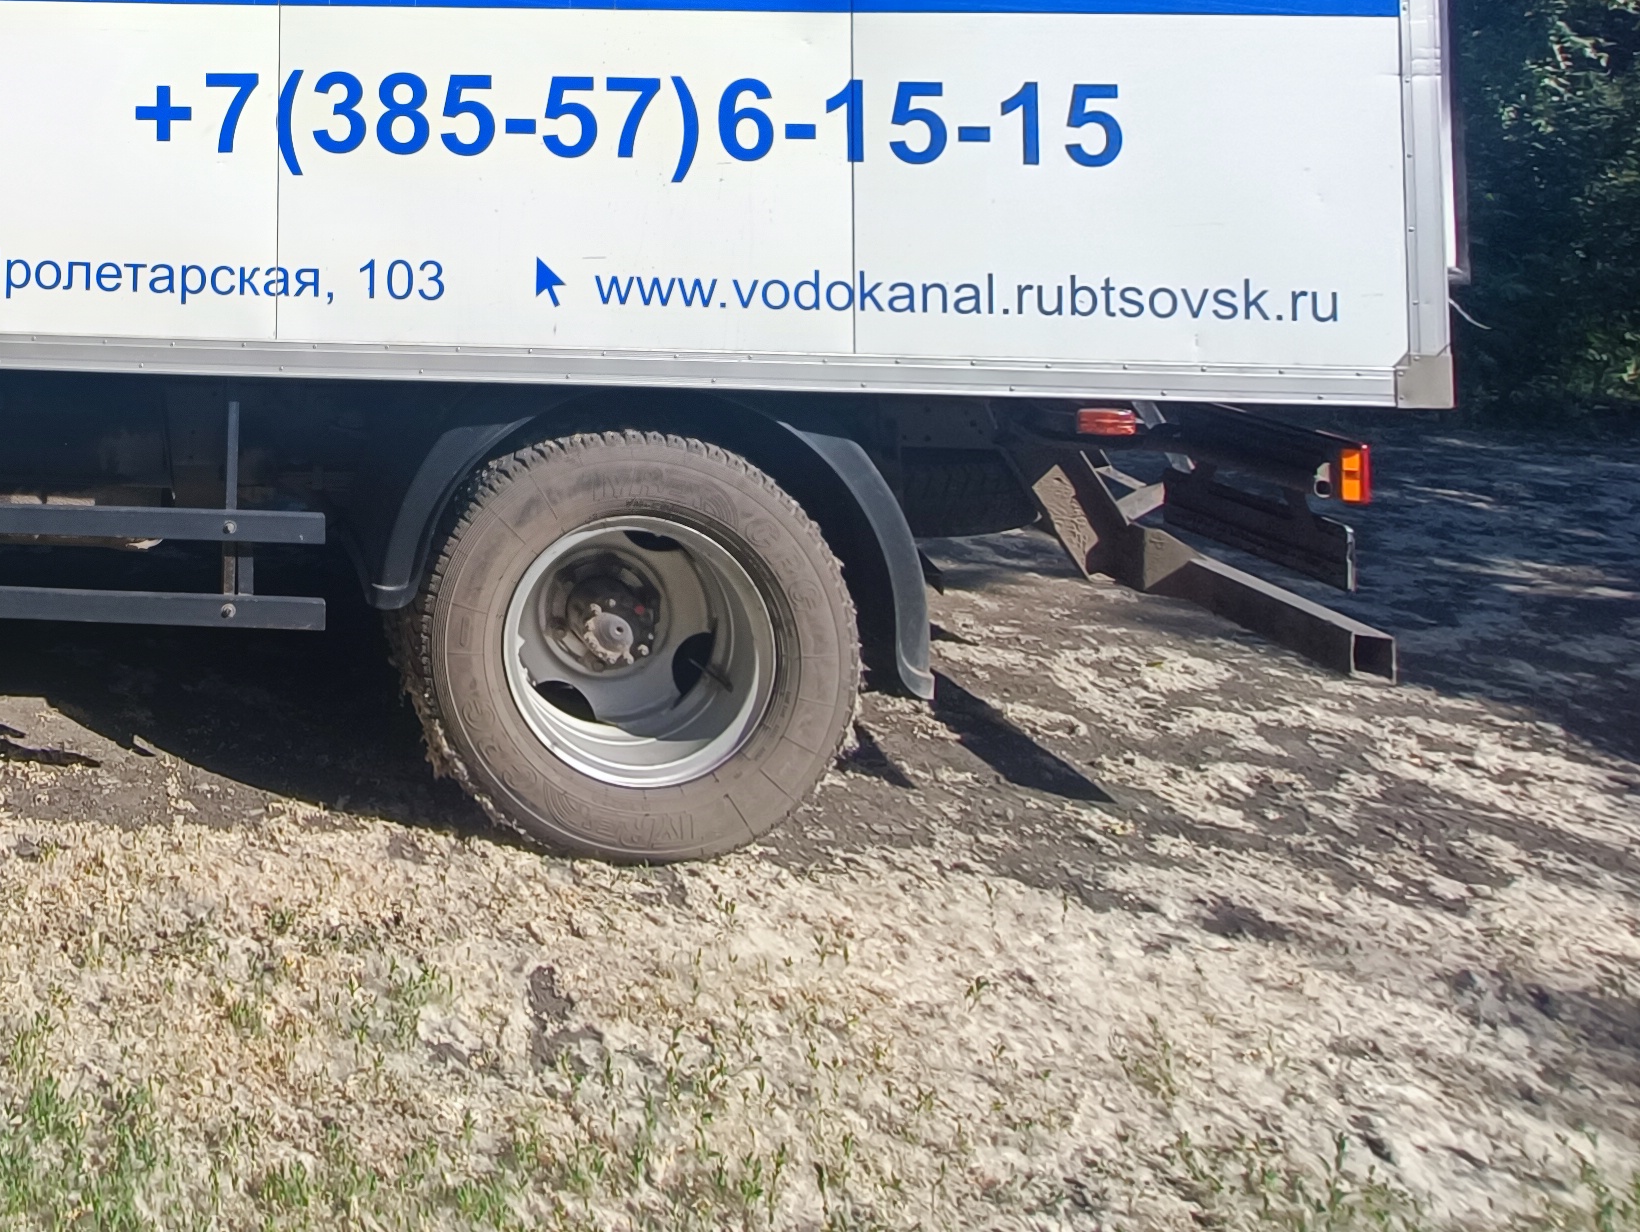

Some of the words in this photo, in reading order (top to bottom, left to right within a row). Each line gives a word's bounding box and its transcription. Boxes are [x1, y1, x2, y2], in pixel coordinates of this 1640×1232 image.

[135, 68, 1123, 183] +7(385-57)6-15-15
[358, 258, 446, 301] 103
[594, 269, 1339, 322] www.vodokanal.rubtsovsk.ru
